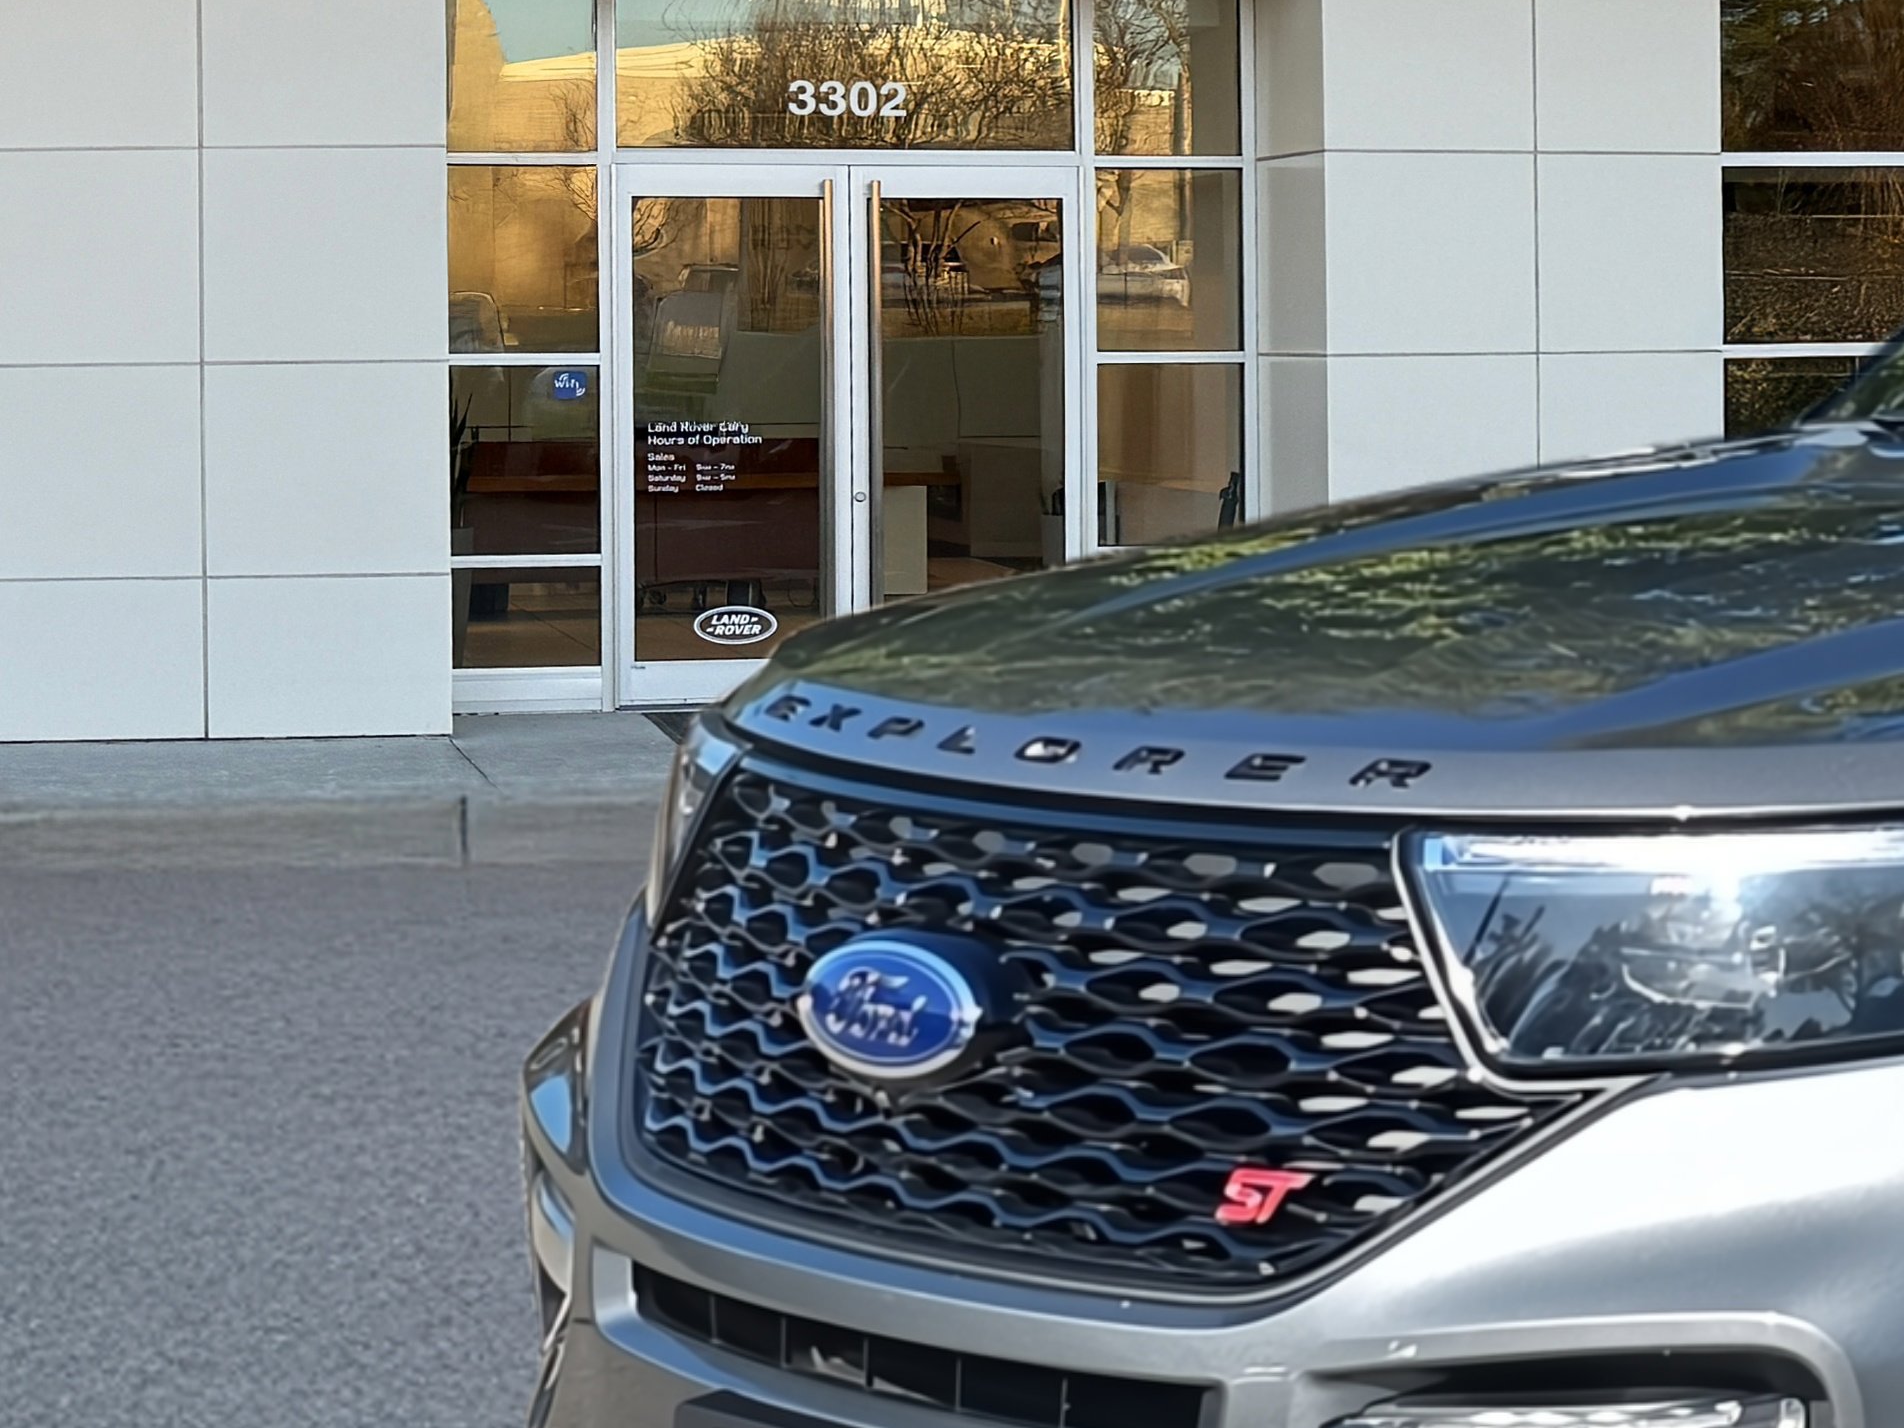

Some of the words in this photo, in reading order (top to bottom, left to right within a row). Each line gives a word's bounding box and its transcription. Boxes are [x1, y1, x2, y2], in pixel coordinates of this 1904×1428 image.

[787, 79, 908, 118] 3302
[647, 421, 678, 433] Land
[647, 435, 685, 445] Hours
[687, 434, 700, 445] of
[703, 434, 763, 447] Operation
[711, 614, 750, 625] LAND
[714, 624, 762, 635] ROVER
[765, 695, 1431, 789] EXPLORER
[825, 966, 928, 1047] Ford
[1214, 1168, 1316, 1225] ST
